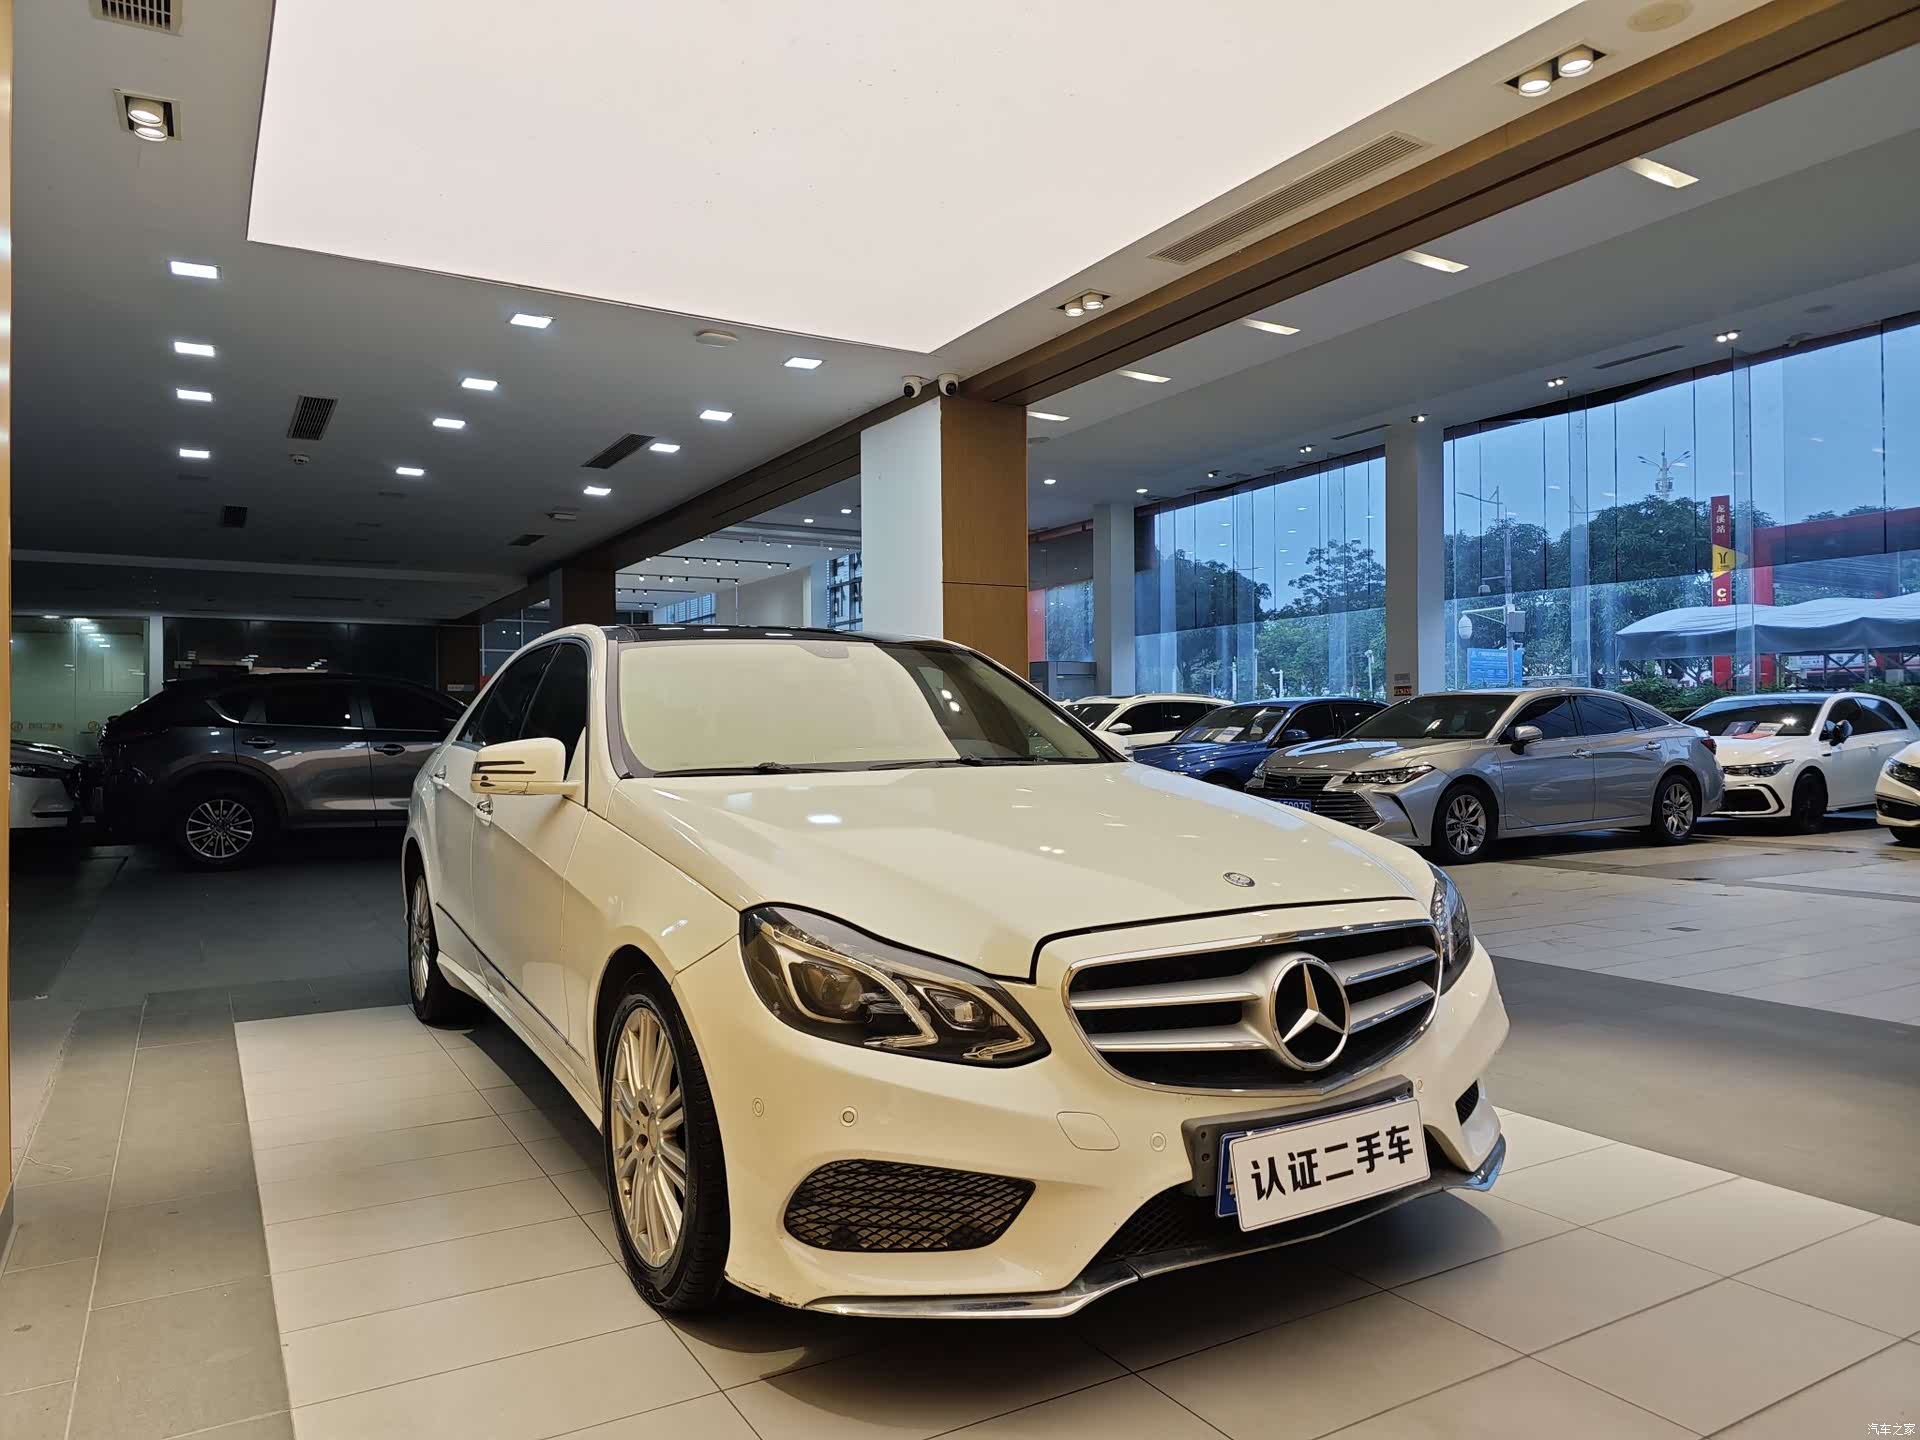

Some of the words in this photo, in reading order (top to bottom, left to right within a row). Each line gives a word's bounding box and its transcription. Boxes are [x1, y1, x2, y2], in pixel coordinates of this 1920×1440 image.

[1716, 588, 1727, 598] C
[1251, 1125, 1413, 1201] 认证二手车
